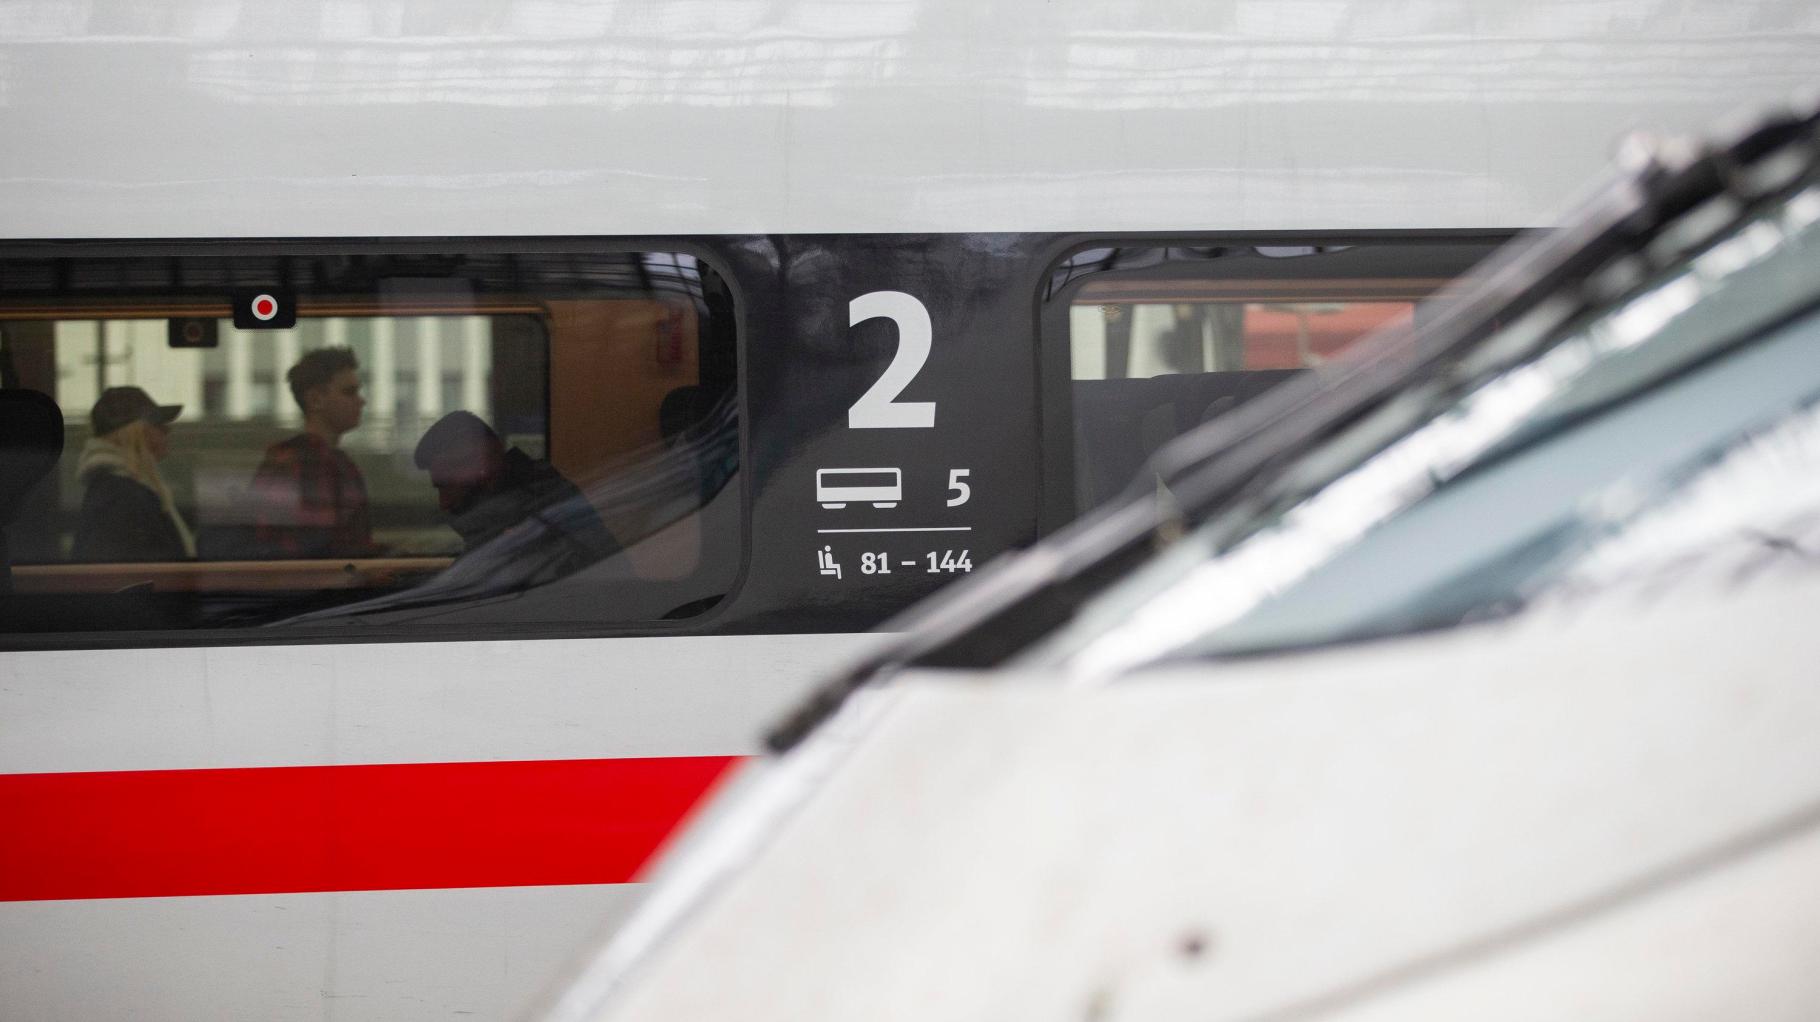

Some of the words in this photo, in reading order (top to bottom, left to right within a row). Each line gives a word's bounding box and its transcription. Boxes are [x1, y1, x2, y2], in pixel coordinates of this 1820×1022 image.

[848, 290, 937, 429] 2
[946, 468, 971, 508] 5
[860, 551, 892, 575] 81
[926, 549, 973, 573] 144
